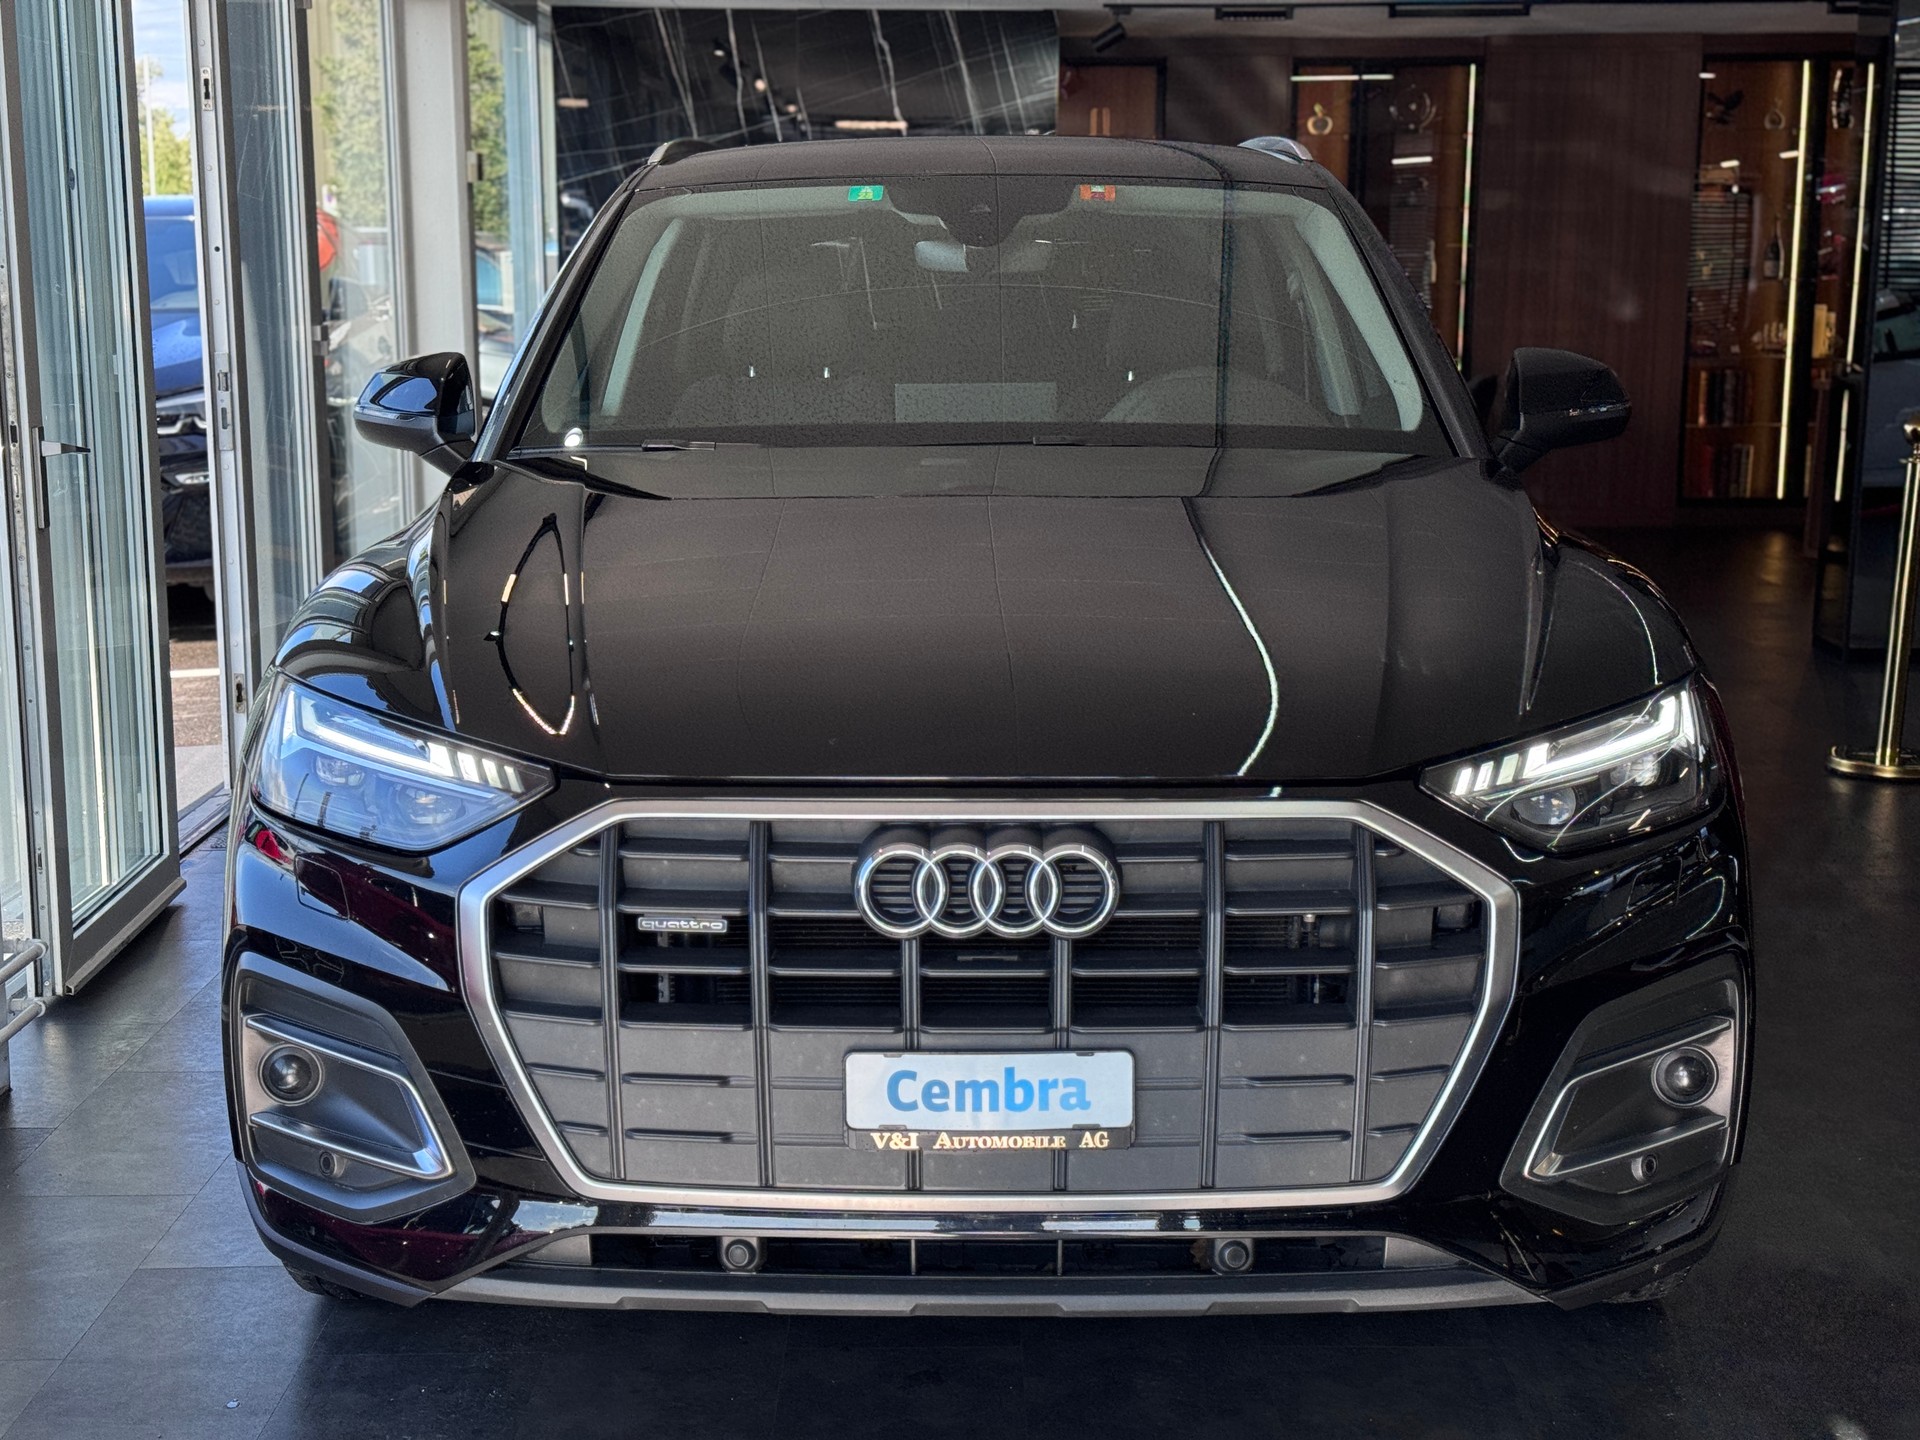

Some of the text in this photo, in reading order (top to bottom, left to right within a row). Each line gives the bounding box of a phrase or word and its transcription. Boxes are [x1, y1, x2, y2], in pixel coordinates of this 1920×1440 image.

[641, 920, 723, 930] quattro
[886, 1066, 1091, 1112] Cembra
[870, 1132, 919, 1150] V&I
[1079, 1130, 1110, 1148] AG
